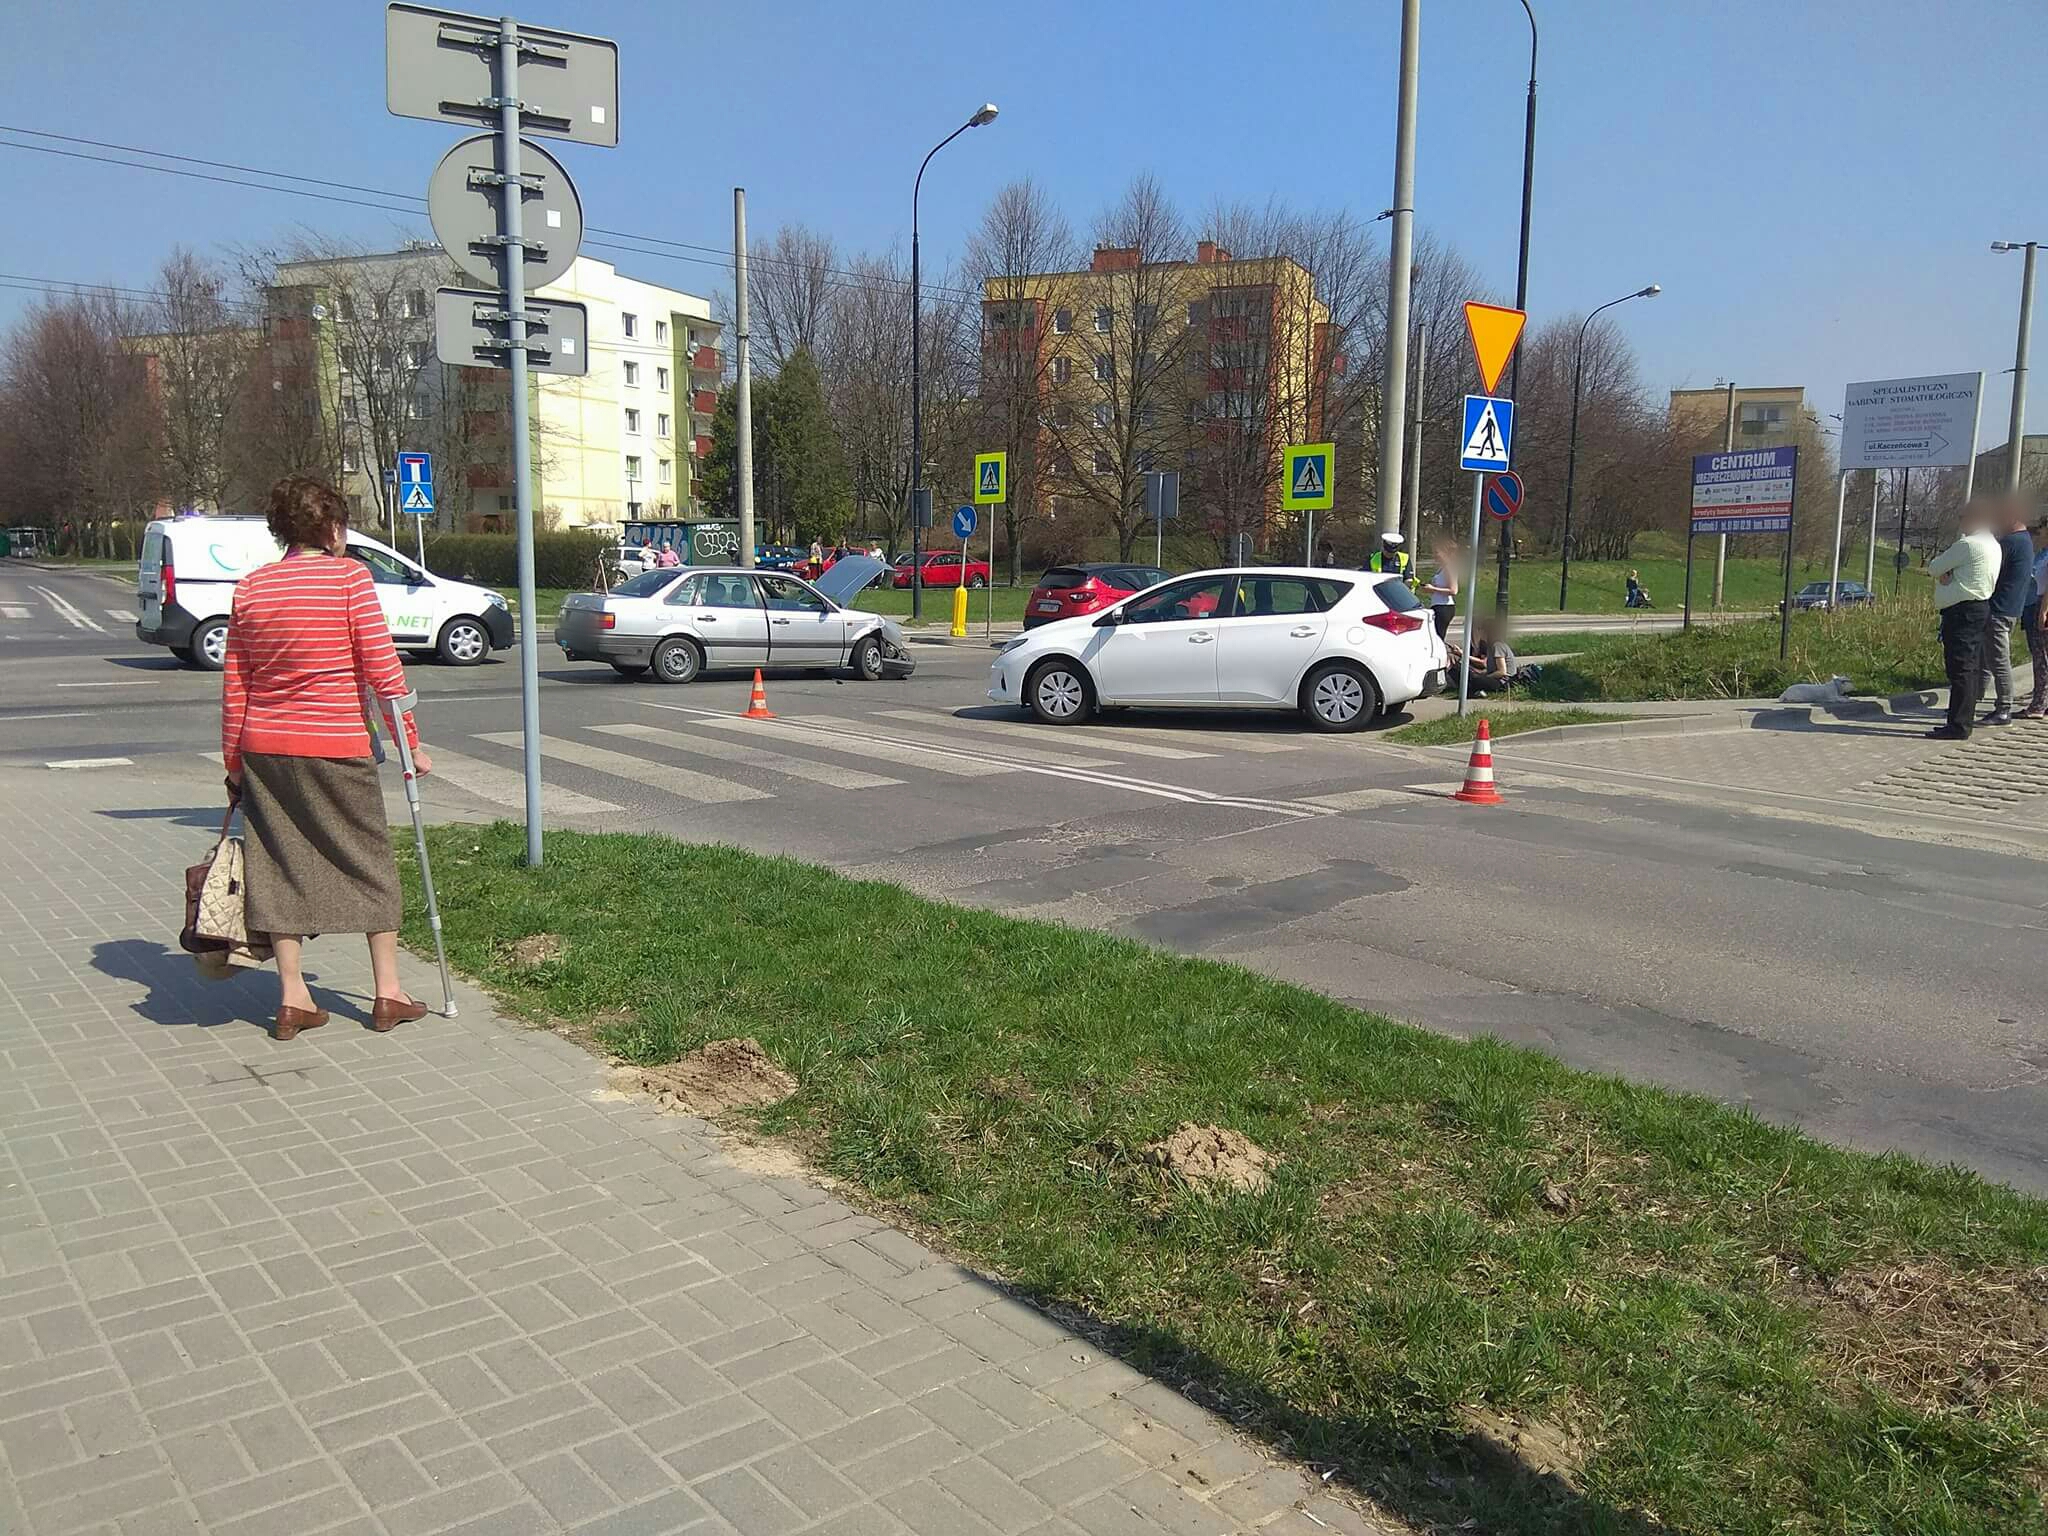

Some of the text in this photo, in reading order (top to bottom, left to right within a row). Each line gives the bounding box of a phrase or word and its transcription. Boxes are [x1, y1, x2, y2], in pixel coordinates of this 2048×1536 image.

[1872, 383, 1950, 396] SPECJALISTYCZNY
[1848, 391, 1974, 408] GABINET STOMATOLOGICZNY
[1712, 452, 1775, 470] CENTRUM
